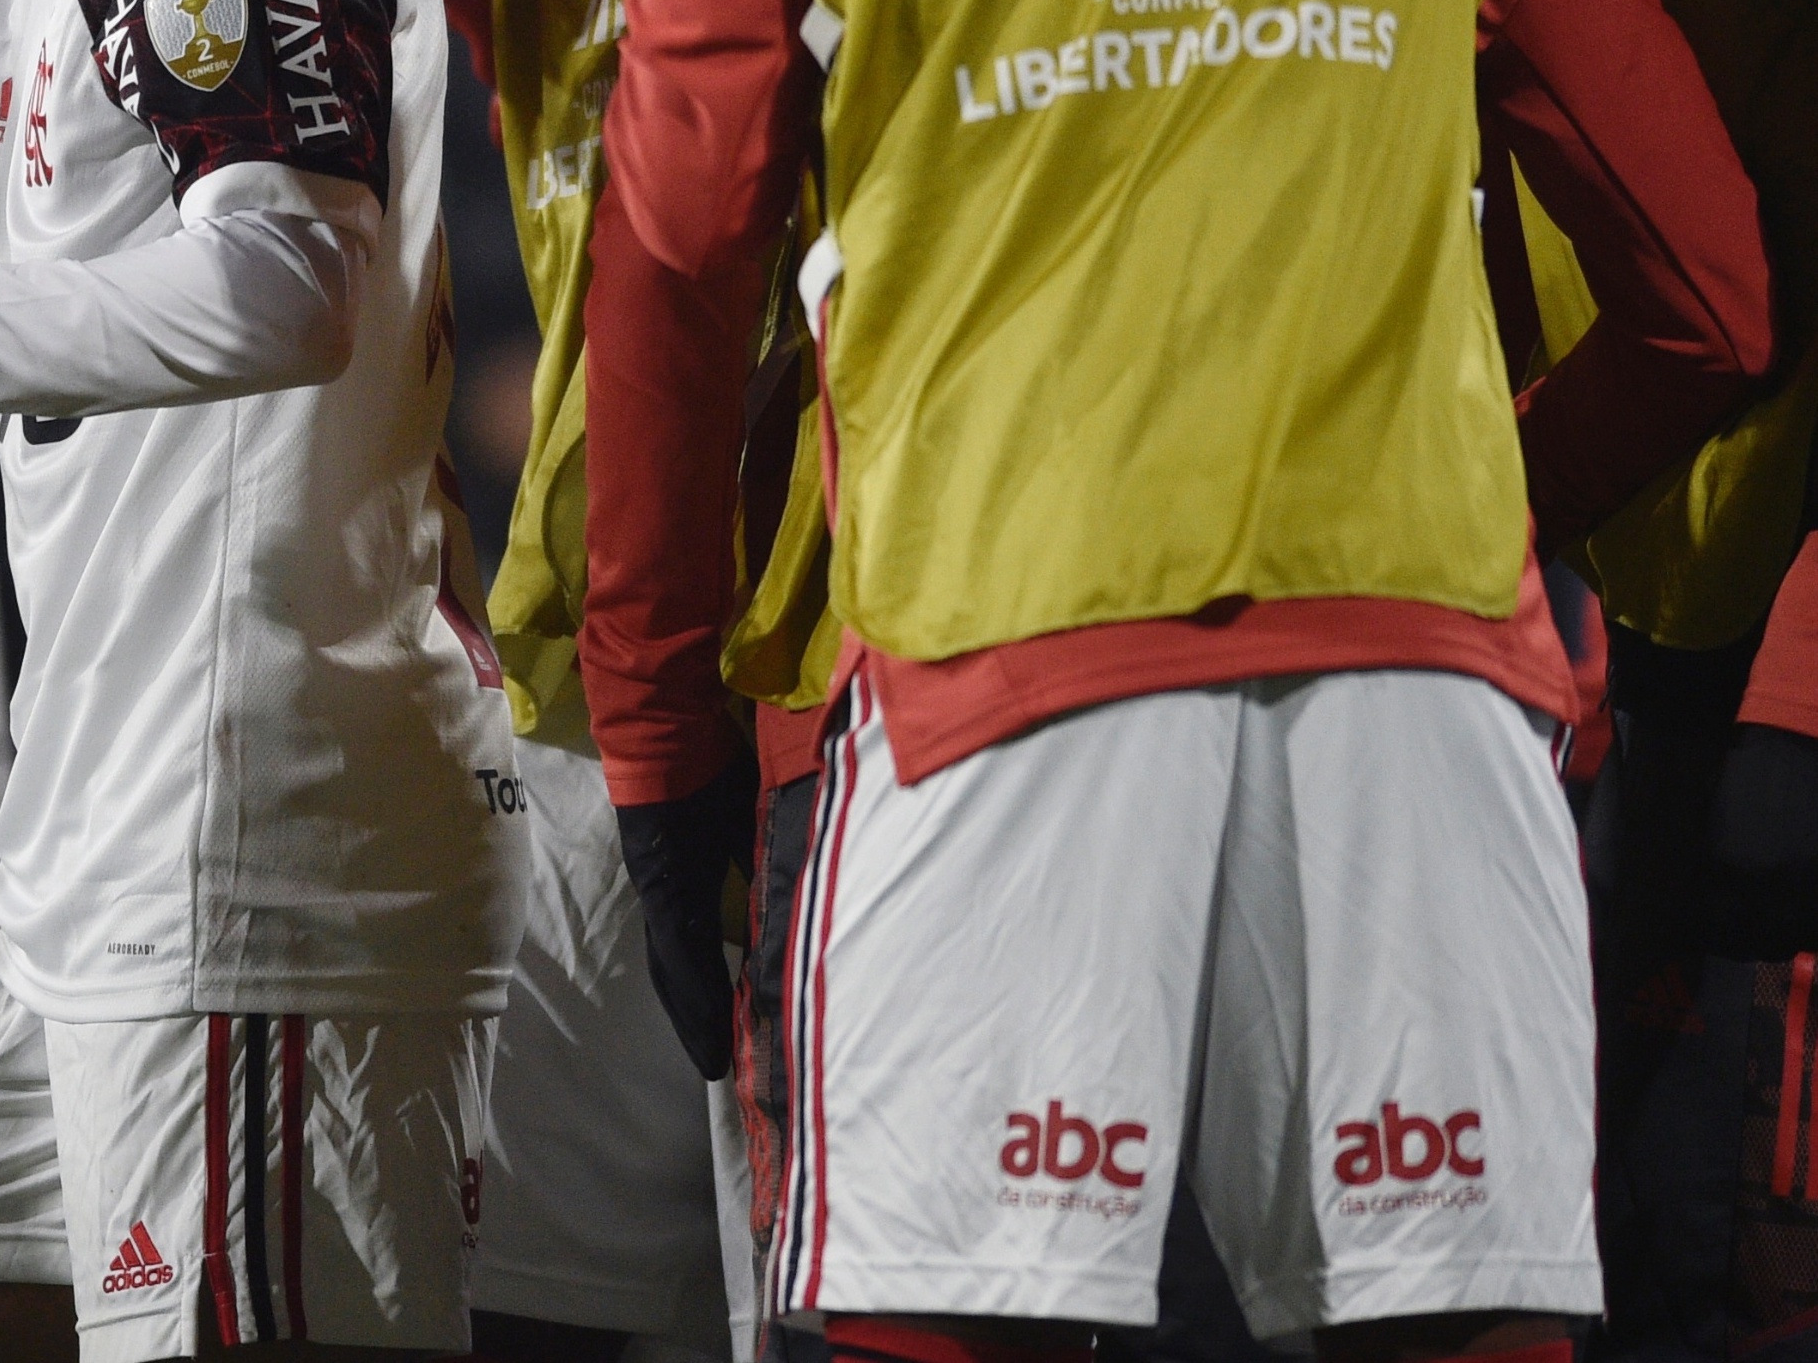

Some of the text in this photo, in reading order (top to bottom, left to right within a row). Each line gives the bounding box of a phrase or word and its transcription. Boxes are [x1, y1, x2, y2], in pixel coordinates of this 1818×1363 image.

[195, 38, 214, 63] 2
[954, 0, 1399, 124] LIBERTADORES
[186, 59, 231, 80] CONMEBOL
[107, 942, 156, 956] AEROREADY
[998, 1099, 1149, 1189] abc
[1333, 1101, 1485, 1187] abc
[102, 1264, 174, 1295] adidas
